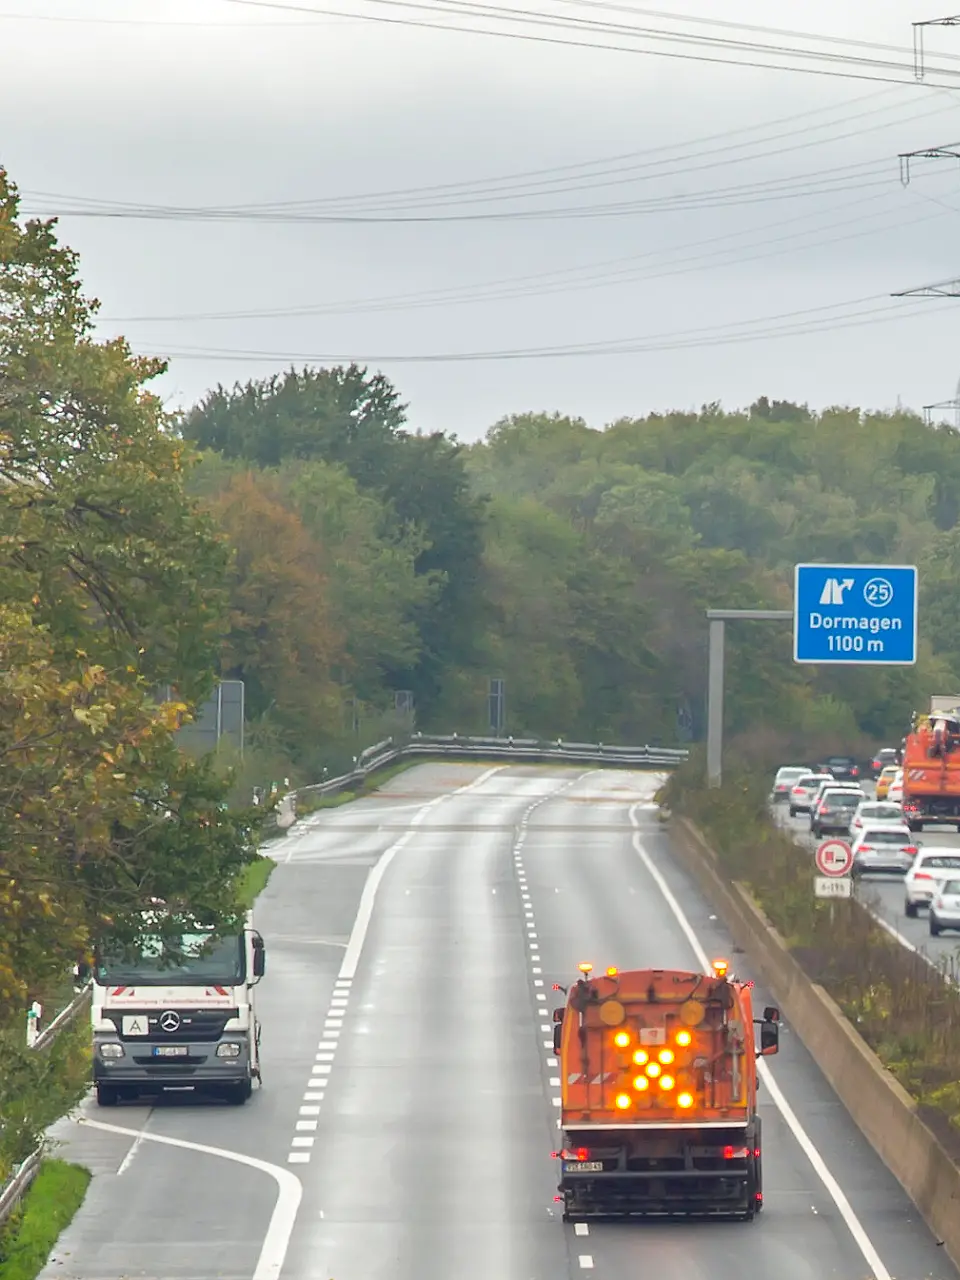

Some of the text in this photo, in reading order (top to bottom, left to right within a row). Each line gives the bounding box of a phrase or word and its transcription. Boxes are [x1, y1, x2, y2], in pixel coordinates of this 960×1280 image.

[868, 585, 889, 601] 25
[809, 612, 902, 634] Dormagen
[827, 635, 884, 652] 1100 m
[129, 1019, 142, 1032] A
